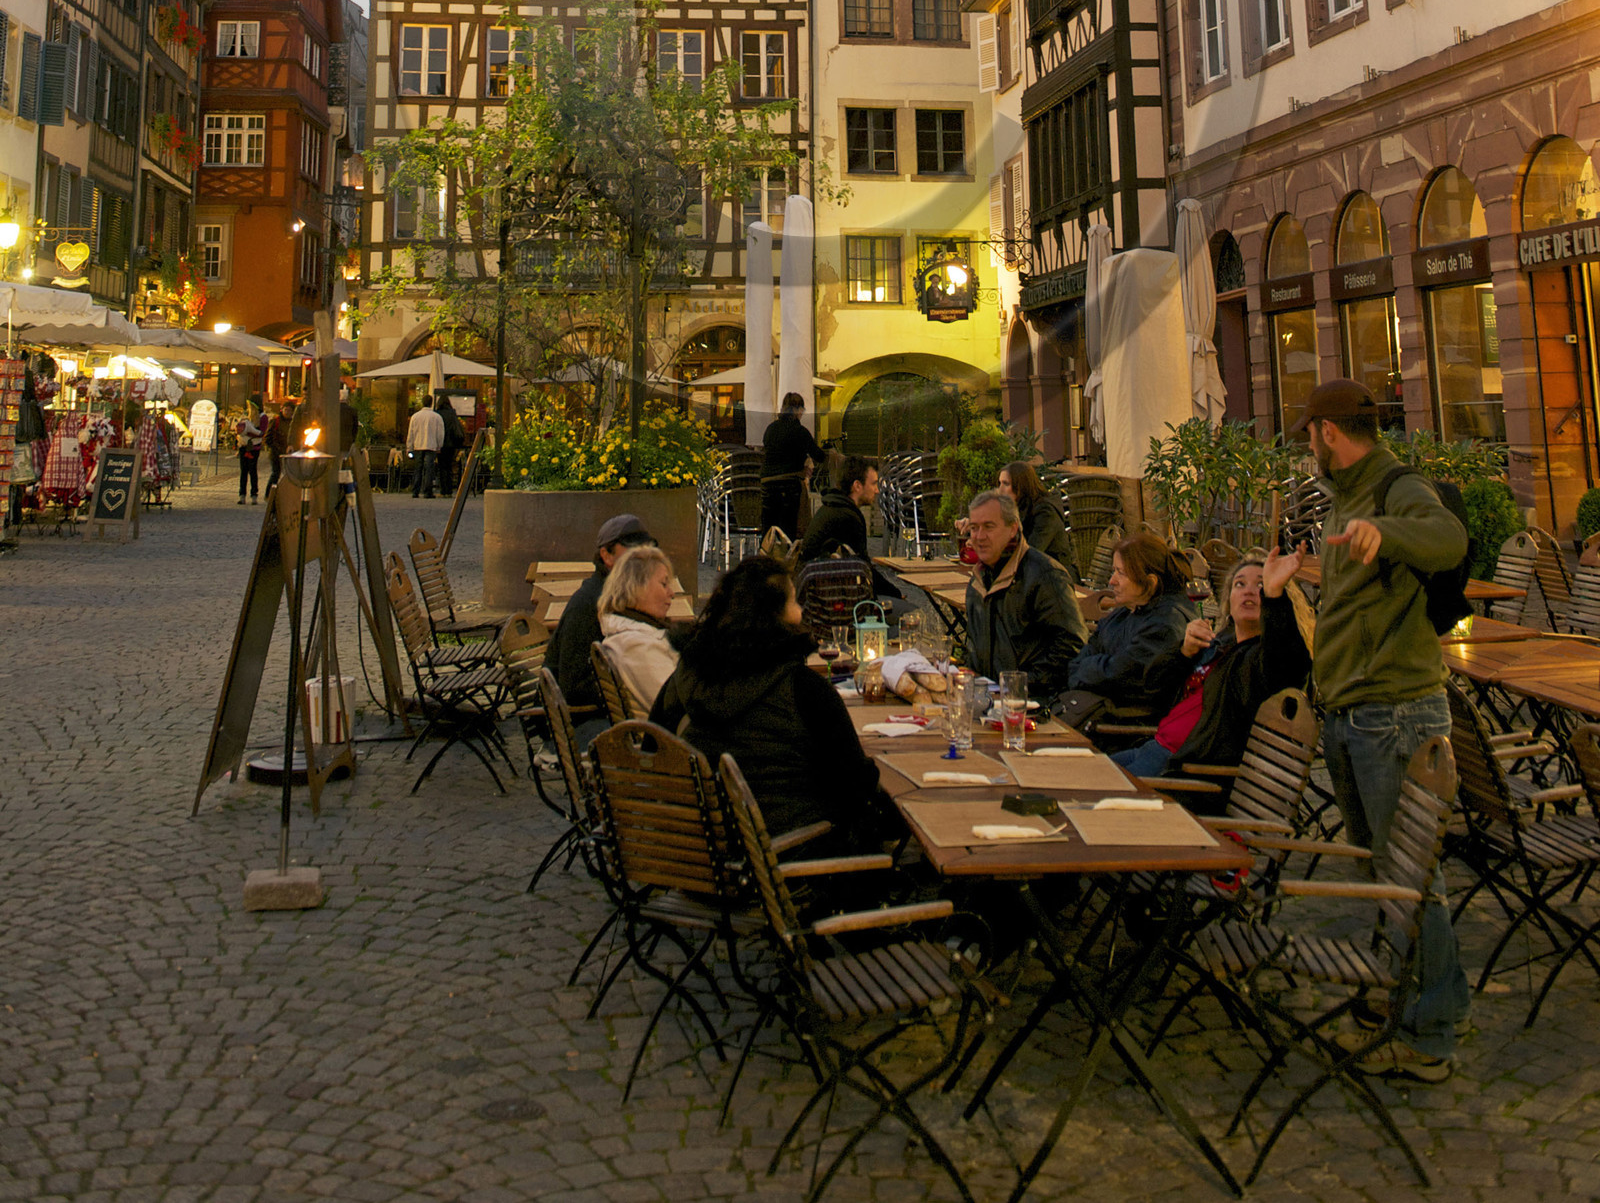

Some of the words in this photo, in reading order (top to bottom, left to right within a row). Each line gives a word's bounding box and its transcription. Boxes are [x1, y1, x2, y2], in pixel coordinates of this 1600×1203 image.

[1519, 234, 1552, 266] CAFE
[1552, 231, 1573, 260] DE
[1426, 256, 1448, 276] Salon
[1447, 256, 1457, 273] de
[1458, 250, 1474, 270] Thé
[1343, 270, 1377, 290] Pâtisserie
[1270, 283, 1302, 303] Restaurant
[107, 458, 133, 469] Boutique
